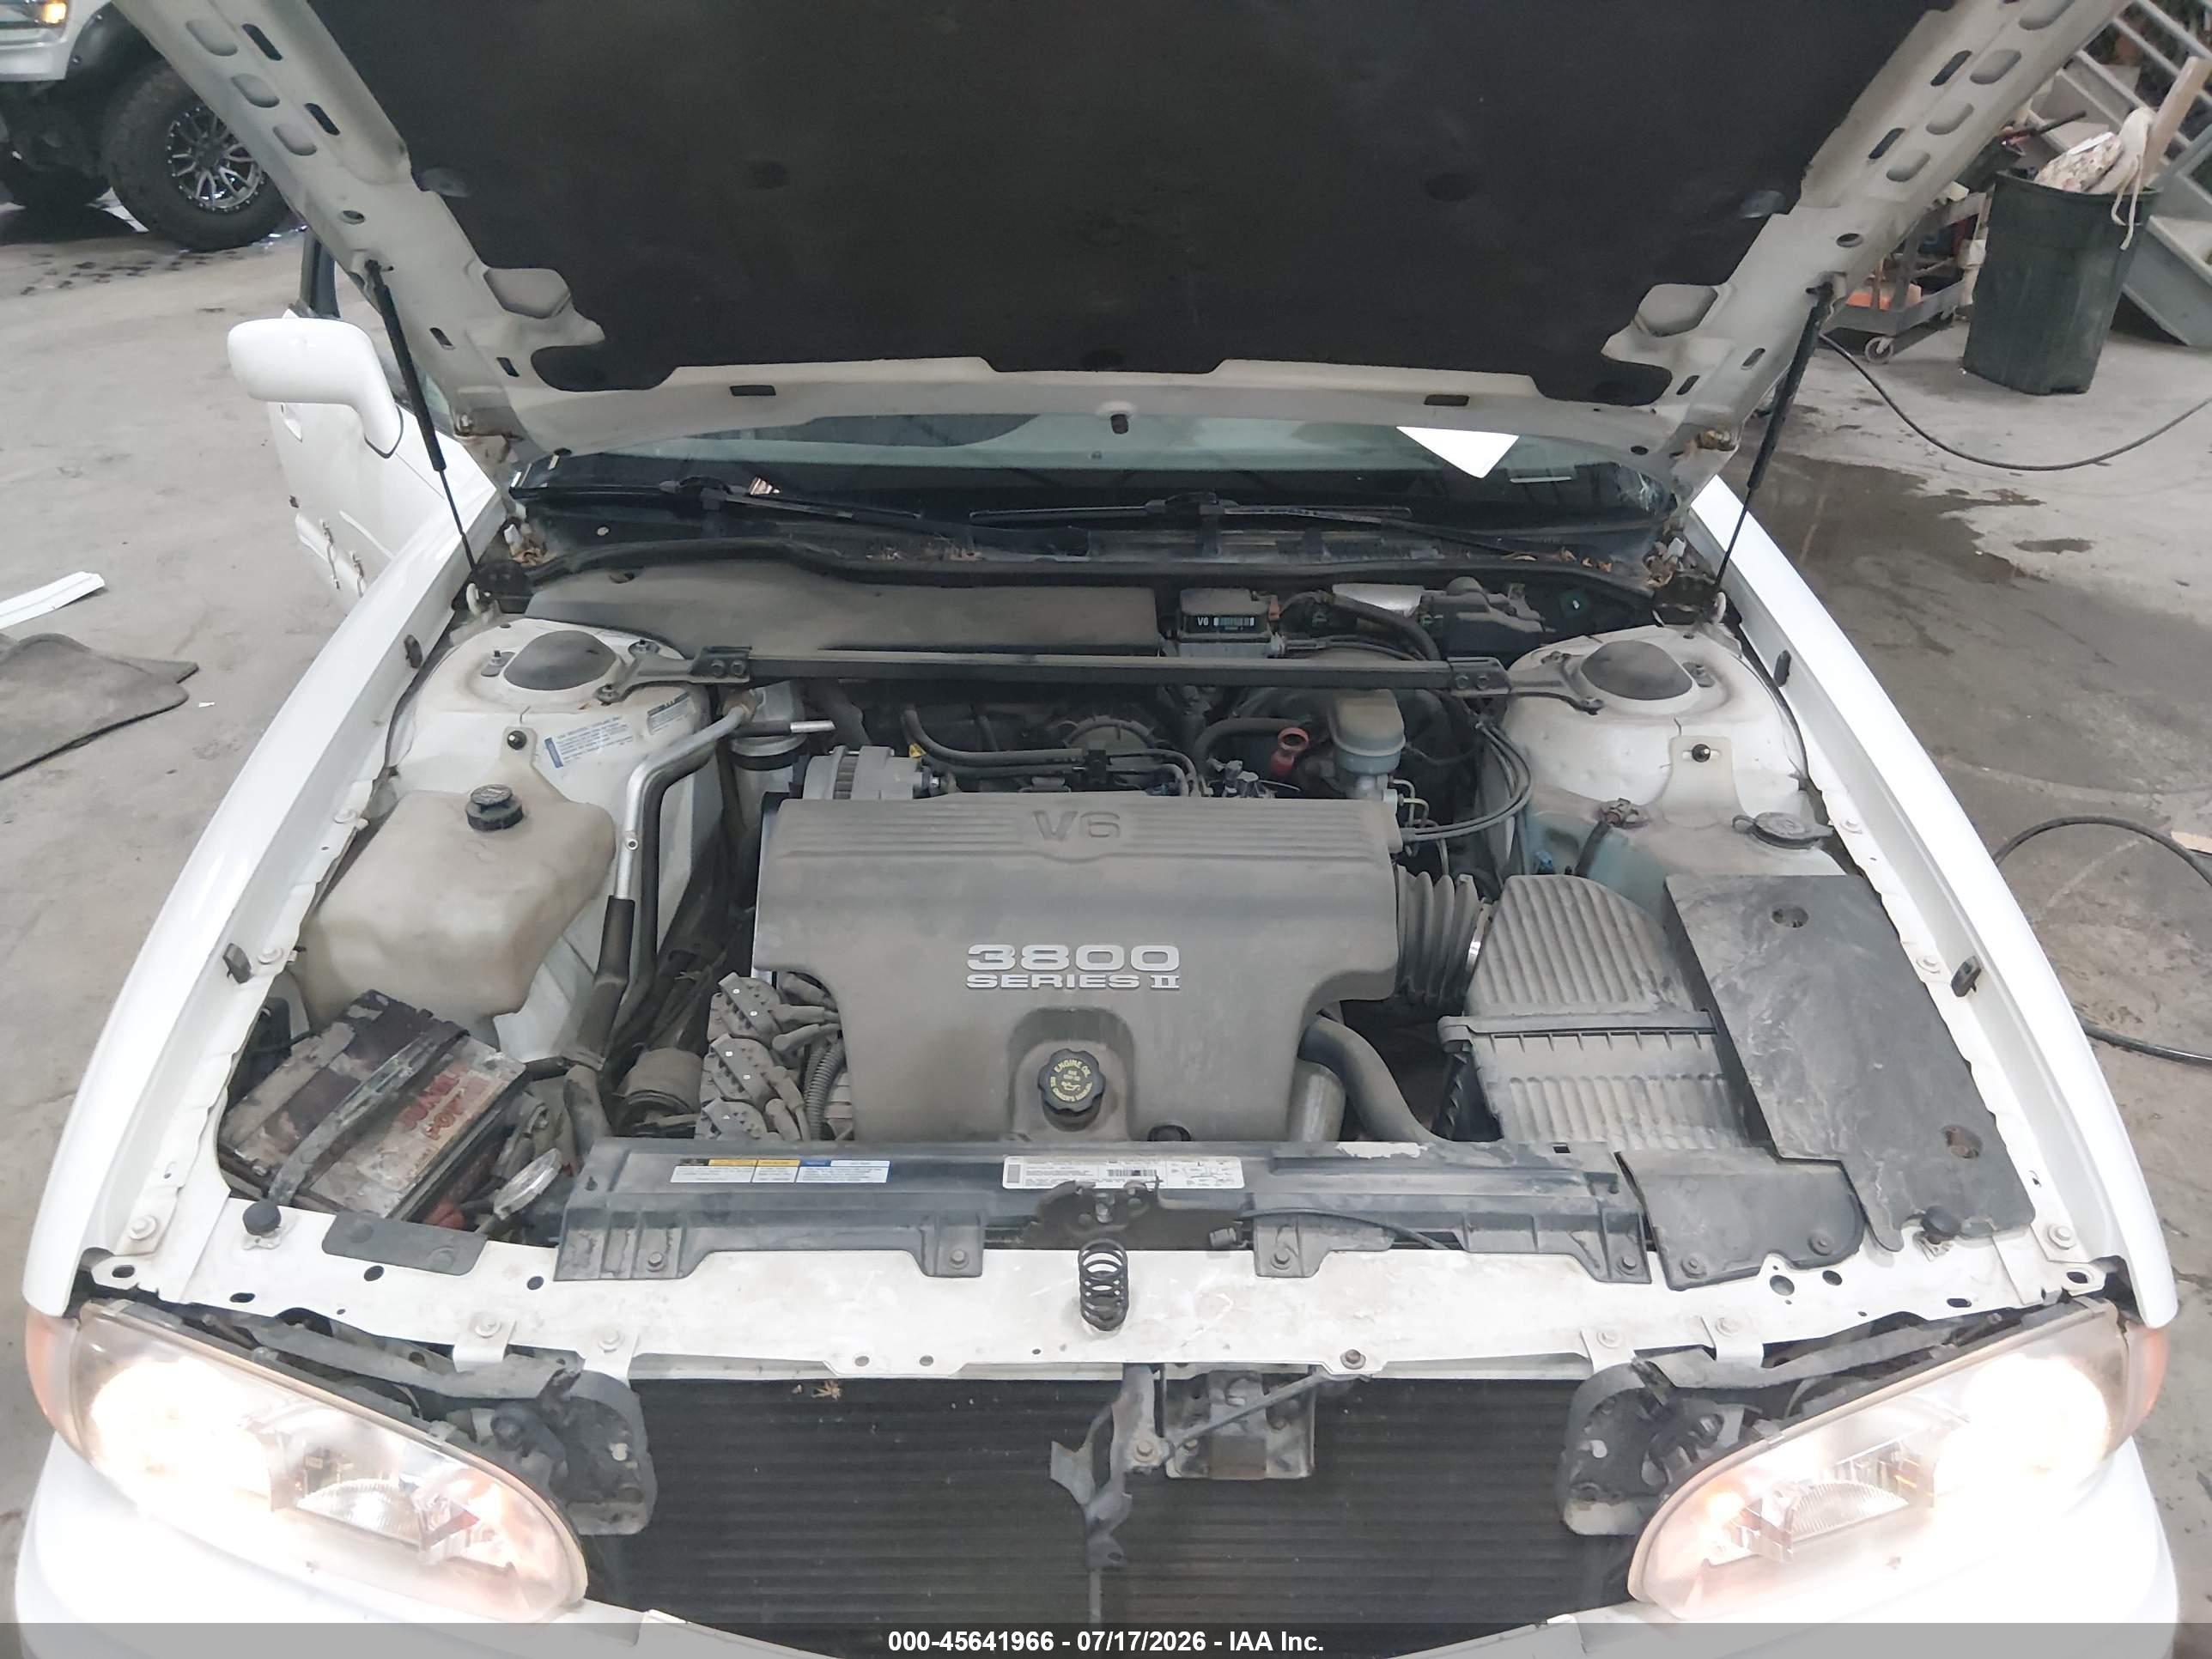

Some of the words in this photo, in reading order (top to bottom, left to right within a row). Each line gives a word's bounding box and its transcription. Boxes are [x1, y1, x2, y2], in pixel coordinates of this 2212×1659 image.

[1032, 810, 1121, 842] V6
[967, 944, 1181, 971] 3800
[966, 973, 1140, 989] SERIES
[1151, 974, 1182, 989] II
[1054, 1059, 1083, 1073] ENGINE
[1081, 1065, 1091, 1078] OIL
